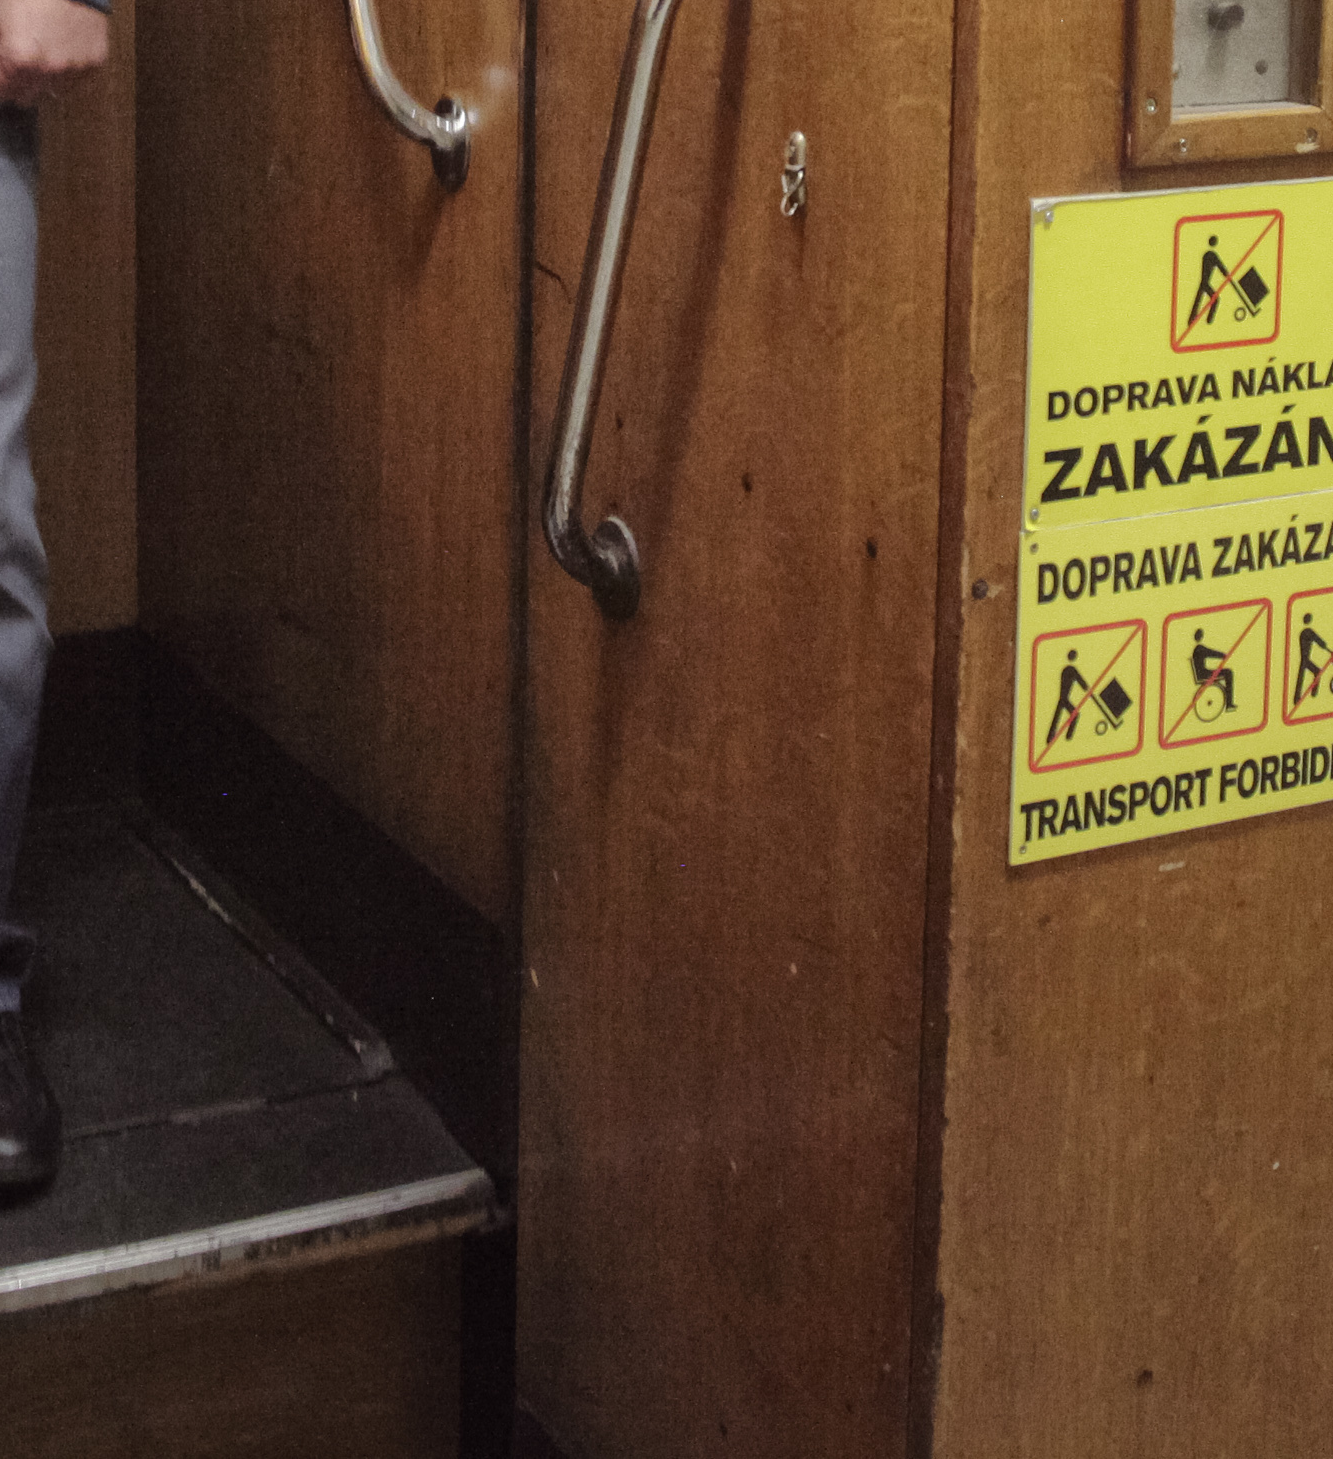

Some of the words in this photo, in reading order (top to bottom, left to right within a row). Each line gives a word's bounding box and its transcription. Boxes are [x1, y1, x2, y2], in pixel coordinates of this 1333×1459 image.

[1047, 372, 1221, 422] DOPRAVA
[1037, 542, 1203, 605] DOPRAVA
[1020, 768, 1213, 843] TRANSPORT
